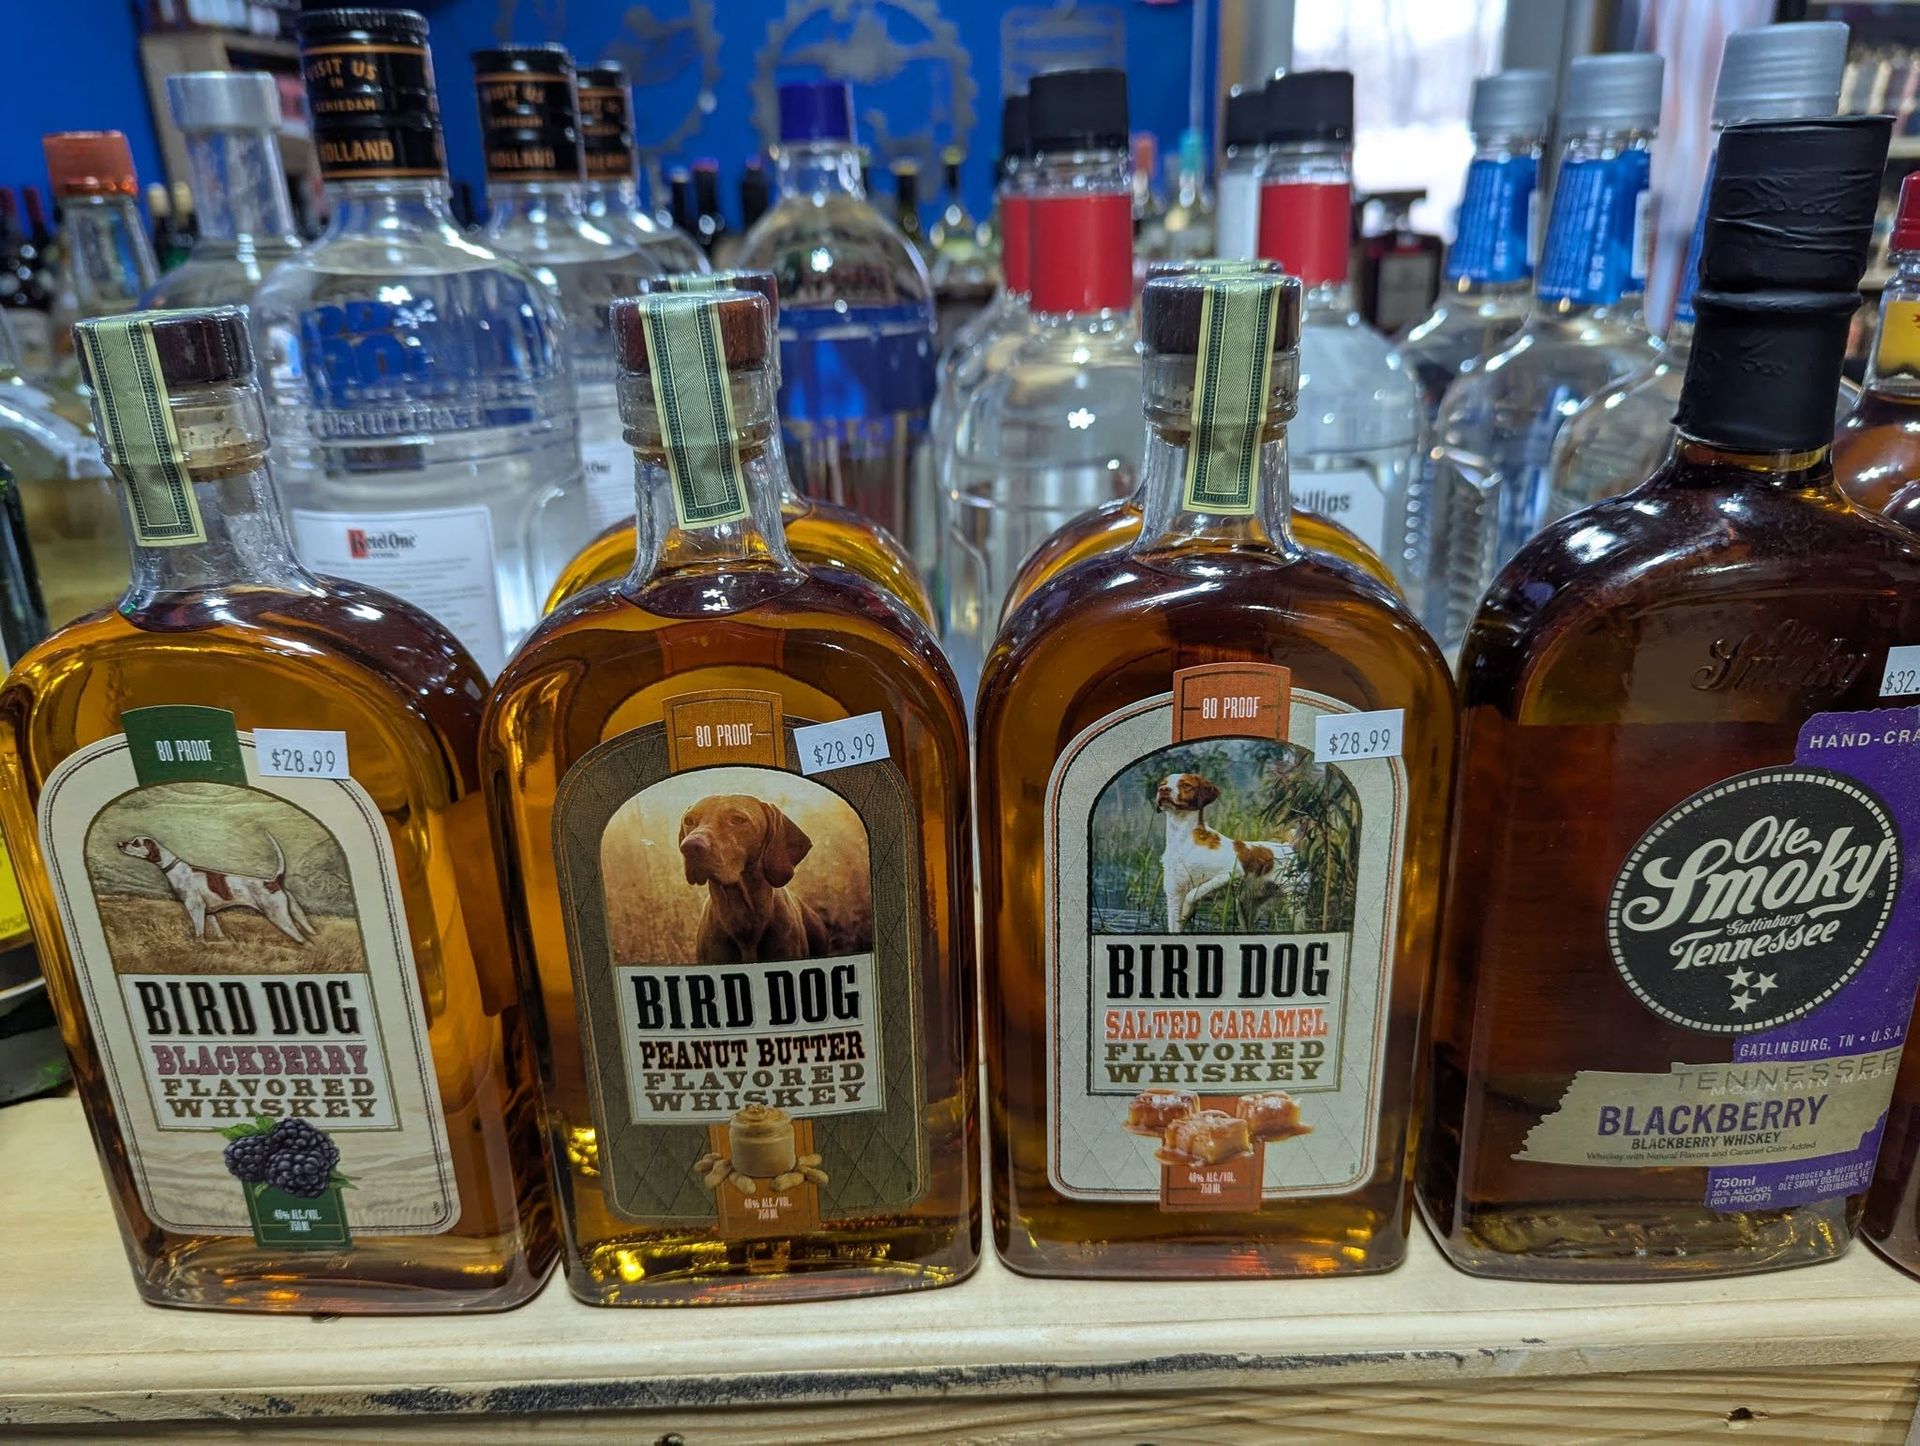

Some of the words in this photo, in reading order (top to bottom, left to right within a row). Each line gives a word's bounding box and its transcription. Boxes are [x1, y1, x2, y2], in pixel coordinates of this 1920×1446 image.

[351, 60, 378, 81] US
[1202, 697, 1218, 720] 80
[1222, 696, 1261, 719] PROOF
[695, 725, 712, 748] 80
[716, 723, 754, 747] PROOF
[1328, 728, 1391, 756] $28.99
[155, 740, 175, 762] 80
[175, 739, 213, 762] PROOF
[271, 748, 337, 773] $28.99
[813, 733, 876, 767] $28.99
[1735, 815, 1822, 865] Ole
[1621, 826, 1897, 933] Smoky
[1726, 912, 1805, 937] Gatlinburg
[1669, 918, 1841, 971] Tennessee
[1106, 943, 1225, 1000] BIRD
[1237, 942, 1330, 998] DOG
[134, 980, 258, 1036] BIRD
[260, 980, 361, 1036] DOG
[631, 973, 755, 1030] BIRD
[764, 964, 861, 1026] DOG
[1104, 1009, 1202, 1041] SALTED
[1208, 1007, 1329, 1041] CARAMEL
[639, 1038, 748, 1070] PEANUT
[756, 1030, 866, 1067] BUTTER
[1104, 1040, 1326, 1062] FLAVORED
[1740, 1037, 1831, 1057] GATLINBURG,
[1839, 1034, 1855, 1049] TN
[150, 1045, 370, 1076] BLACKBERRY
[1104, 1061, 1325, 1083] WHISKEY
[1671, 1048, 1901, 1091] TENNESSEE
[643, 1062, 866, 1091] FLAVORED
[1840, 1064, 1898, 1084] MADE
[160, 1078, 376, 1098] FLAVORED
[644, 1082, 866, 1112] WHISKEY
[165, 1098, 378, 1119] WHISKEY
[1597, 1094, 1829, 1137] BLACKBERRY
[1631, 1135, 1720, 1150] BLACKBERRY
[1723, 1131, 1782, 1147] WHISKEY
[1710, 1149, 1727, 1158] and
[1729, 1147, 1764, 1157] Caramel
[1765, 1145, 1787, 1154] Color
[1789, 1141, 1817, 1152] Added
[1714, 1175, 1756, 1189] 750ml
[1777, 1181, 1793, 1191] OLE
[1793, 1178, 1820, 1190] SMOKY
[1710, 1197, 1727, 1207] (60
[1729, 1192, 1772, 1204] PROOF)
